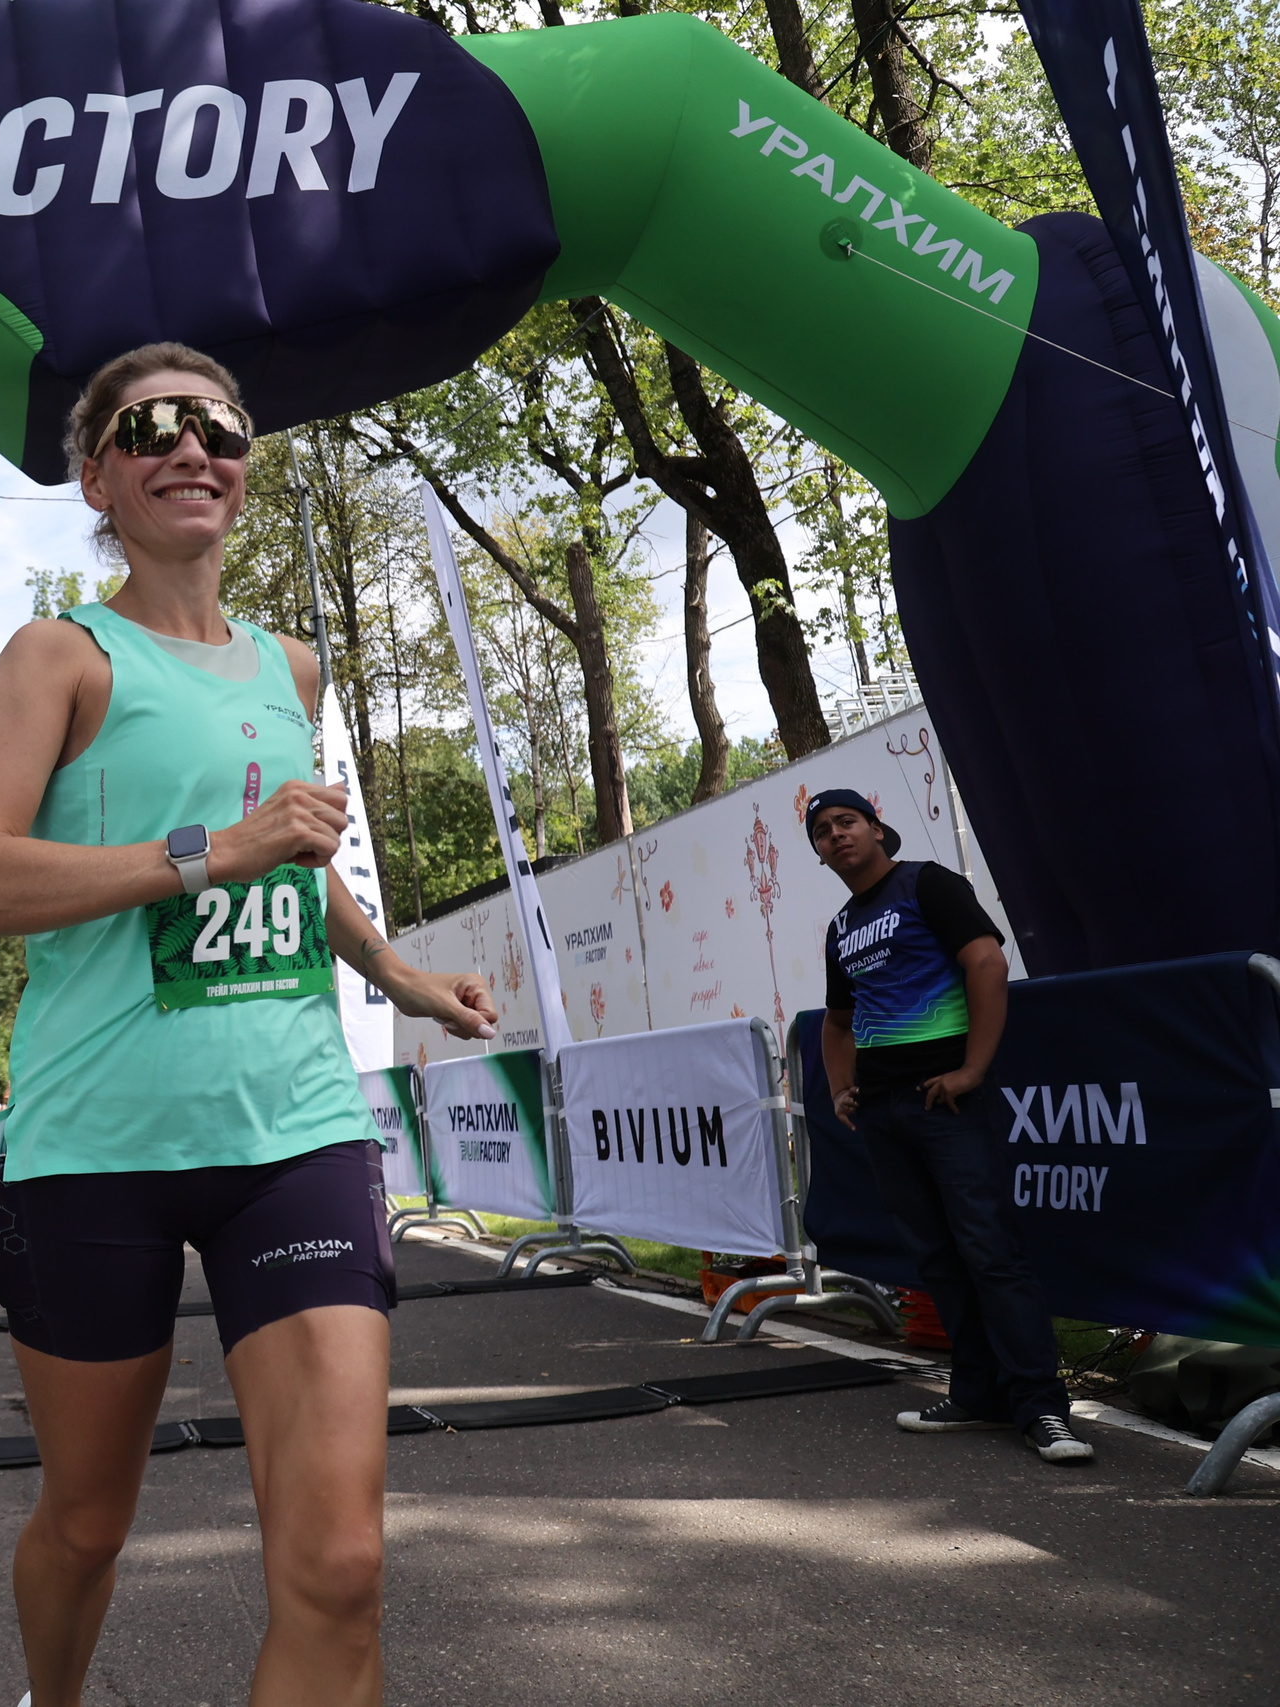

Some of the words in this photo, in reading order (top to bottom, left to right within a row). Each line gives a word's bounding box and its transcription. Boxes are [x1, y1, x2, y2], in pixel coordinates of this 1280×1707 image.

[729, 98, 1015, 304] УРАЛХИМ
[263, 703, 303, 721] УРАЛХИ
[246, 772, 258, 815] BIVIU
[337, 760, 388, 1005] BVIUM
[192, 884, 301, 963] 249
[564, 922, 613, 951] УРАЛХИМ
[845, 948, 891, 974] УРАЛХИМ
[206, 983, 228, 998] ТРЕЙЛ
[229, 981, 261, 996] УРАЛХИМ
[262, 980, 275, 992] RUN
[275, 978, 300, 991] FACTORY
[502, 1028, 539, 1047] УРАЛХИМ
[448, 1103, 519, 1132] УРАЛХИМ
[592, 1106, 728, 1168] BIVIUM
[1014, 1163, 1110, 1212] CTORY
[251, 1239, 354, 1268] УРАЛХИМ
